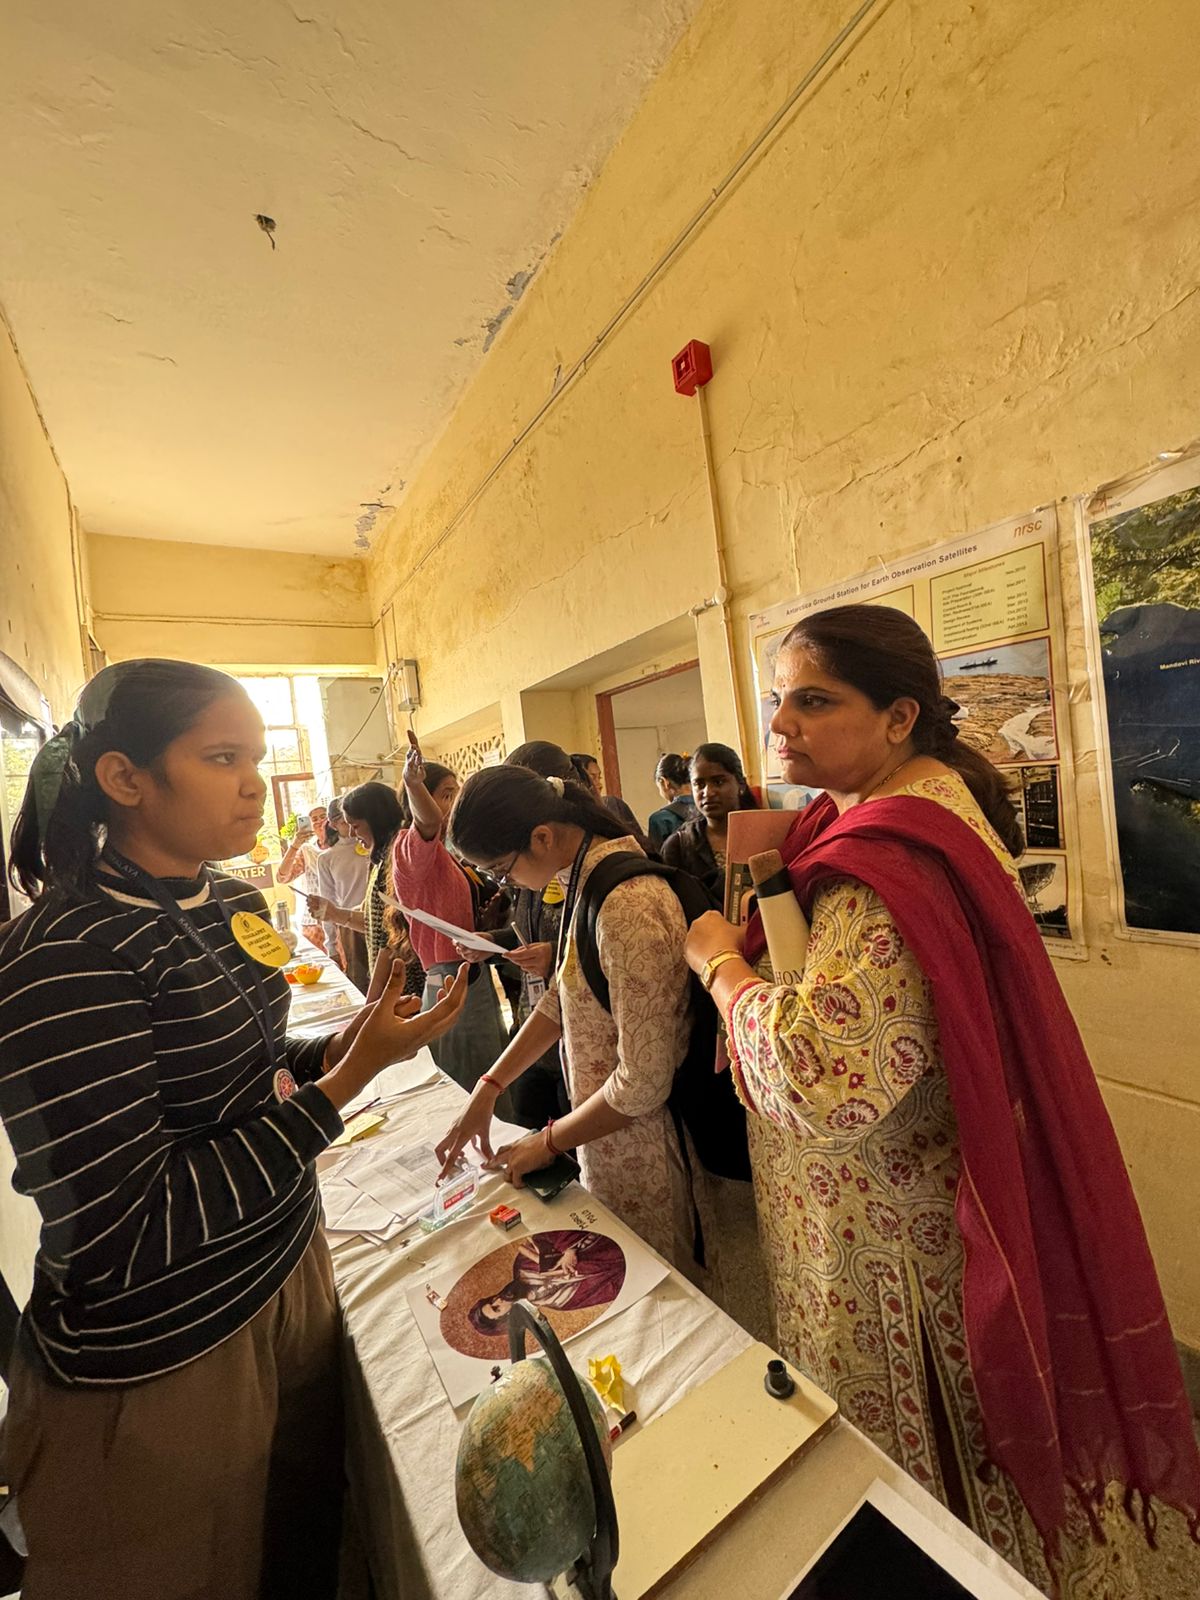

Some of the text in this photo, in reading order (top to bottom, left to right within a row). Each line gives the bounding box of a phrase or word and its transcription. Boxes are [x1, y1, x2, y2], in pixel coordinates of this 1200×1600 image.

[1013, 520, 1042, 538] nrsc
[813, 593, 835, 606] Ground
[836, 586, 859, 599] Station
[860, 581, 870, 591] for
[871, 575, 890, 587] Earth
[892, 560, 936, 580] Observation
[938, 545, 977, 563] Satellites
[1160, 659, 1188, 670] Mandovi
[178, 916, 206, 949] KANORIA
